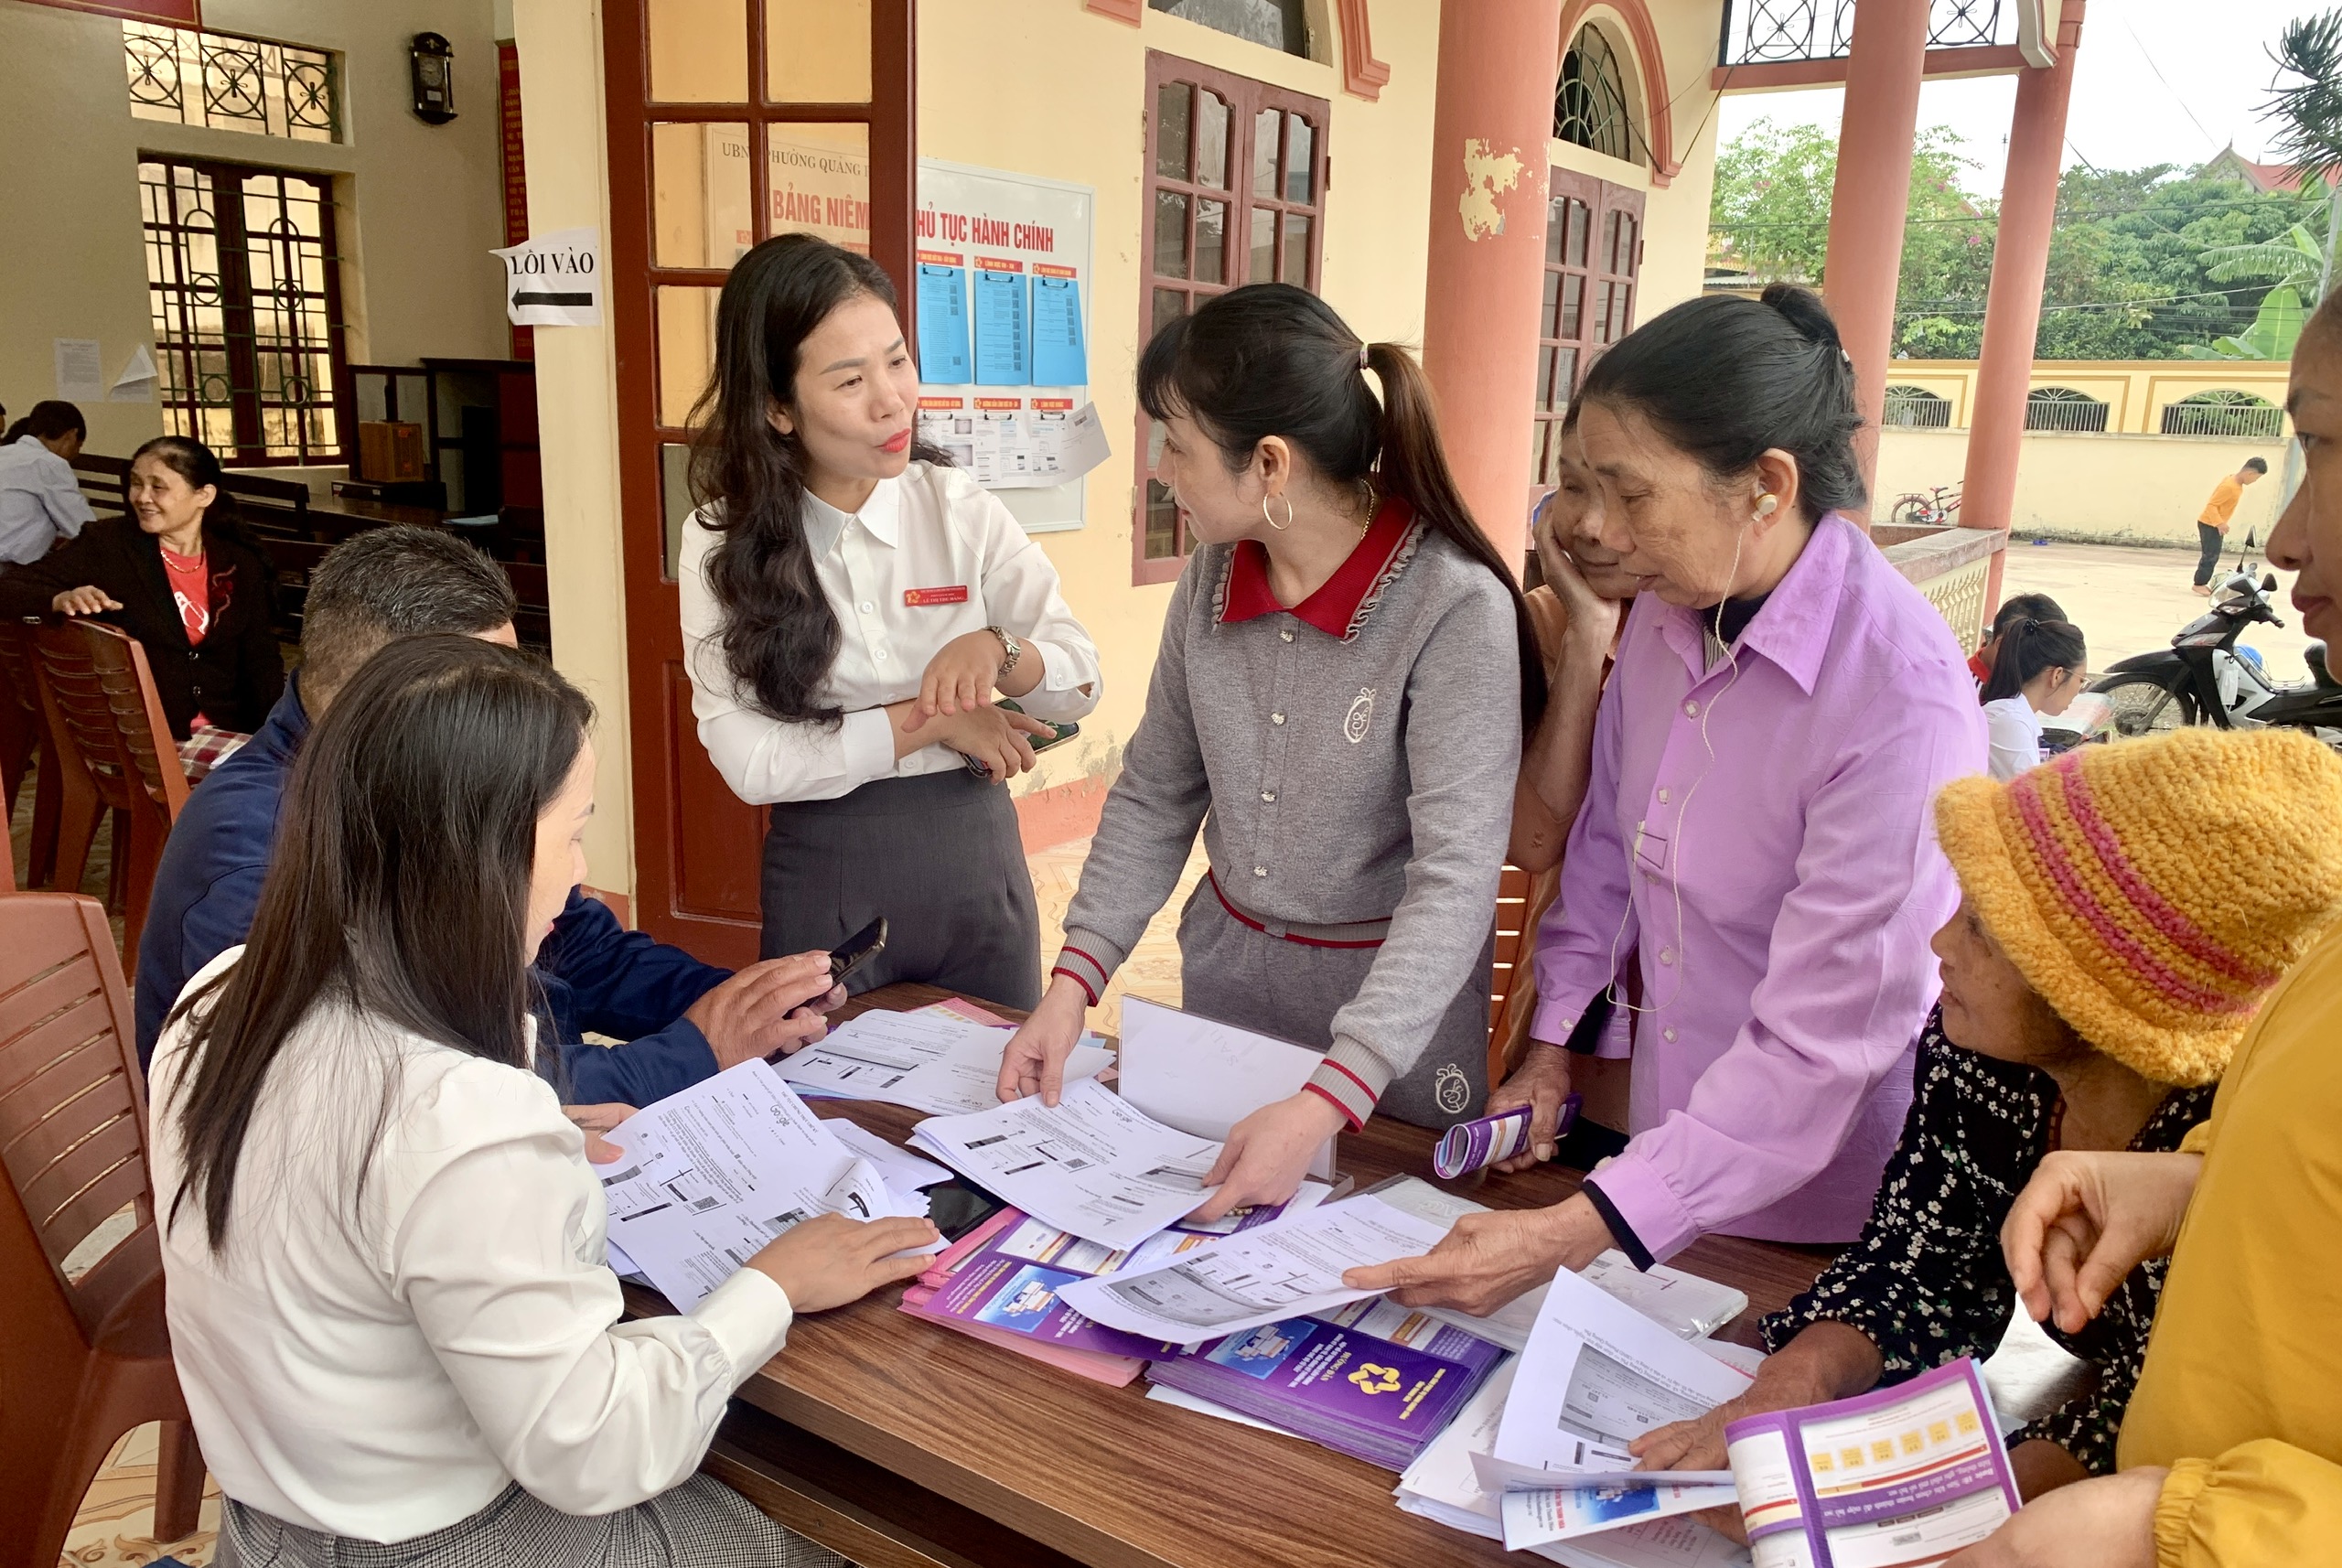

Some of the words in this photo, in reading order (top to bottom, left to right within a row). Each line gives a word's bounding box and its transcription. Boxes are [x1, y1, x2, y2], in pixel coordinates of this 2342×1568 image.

[722, 142, 749, 158] UBN
[768, 148, 816, 168] HƯỜNG
[773, 182, 822, 224] BẢNG
[826, 194, 869, 231] NIÊM
[917, 201, 935, 239] HỦ
[940, 212, 967, 246] TỤC
[972, 213, 1009, 247] HÀNH
[1014, 220, 1053, 252] CHÍNH
[551, 247, 594, 274] VÀO
